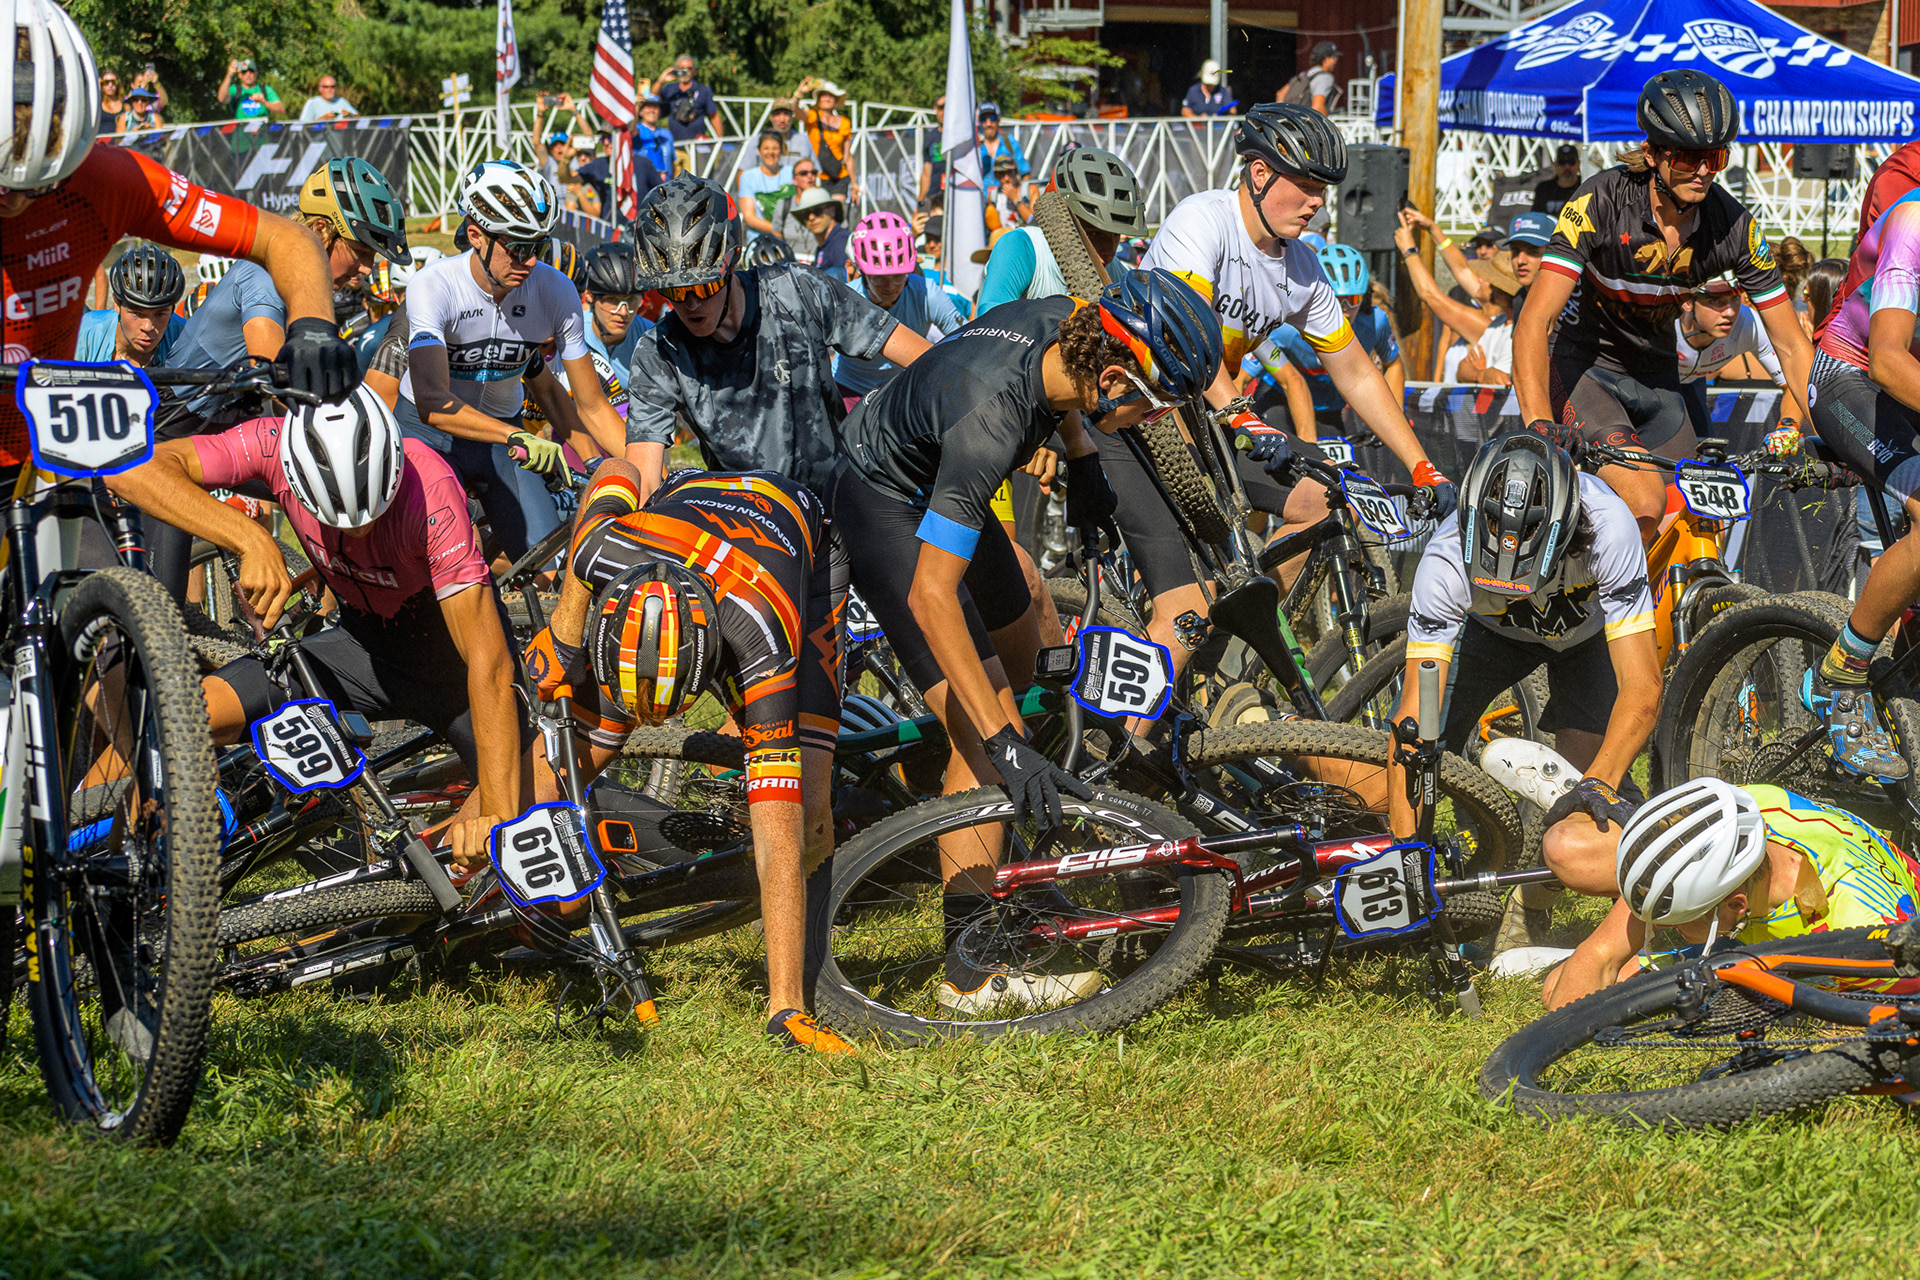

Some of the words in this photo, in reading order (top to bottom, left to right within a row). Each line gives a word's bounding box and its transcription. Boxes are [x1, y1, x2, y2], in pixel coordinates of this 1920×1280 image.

[1693, 22, 1750, 42] USA
[1700, 37, 1755, 51] CYCLING
[1455, 89, 1547, 131] CHAMPIONSHIPS
[1752, 99, 1915, 137] CHAMPIONSHIPS
[262, 191, 300, 211] Hype
[331, 211, 347, 235] SMITH
[1562, 206, 1584, 228] 1850
[27, 242, 70, 271] MiiR
[5, 275, 82, 320] GER
[962, 327, 1035, 347] HENRICO
[1161, 346, 1180, 376] GIRO
[48, 393, 130, 444] 510
[1848, 419, 1875, 447] SPOKE
[1866, 438, 1893, 465] DEVO
[283, 460, 310, 507] MET
[1689, 483, 1740, 510] 548
[683, 499, 737, 514] RACING
[737, 505, 798, 557] DONOVAN
[434, 540, 467, 561] TREK
[309, 543, 400, 589] HATCH
[1474, 576, 1515, 590] COGNATIVE
[1514, 583, 1531, 593] MTB
[596, 617, 607, 656] DONOVAN
[691, 652, 704, 692] DONOVAN
[1107, 642, 1152, 706] 597
[742, 720, 794, 748] Seal
[761, 720, 787, 730] ORANGE
[272, 715, 333, 778] 599
[748, 752, 798, 764] REK
[1108, 795, 1139, 811] CONTROL
[1142, 807, 1153, 818] T7
[512, 826, 566, 889] 616
[1358, 866, 1403, 922] 613
[22, 844, 41, 983] MAXXIS
